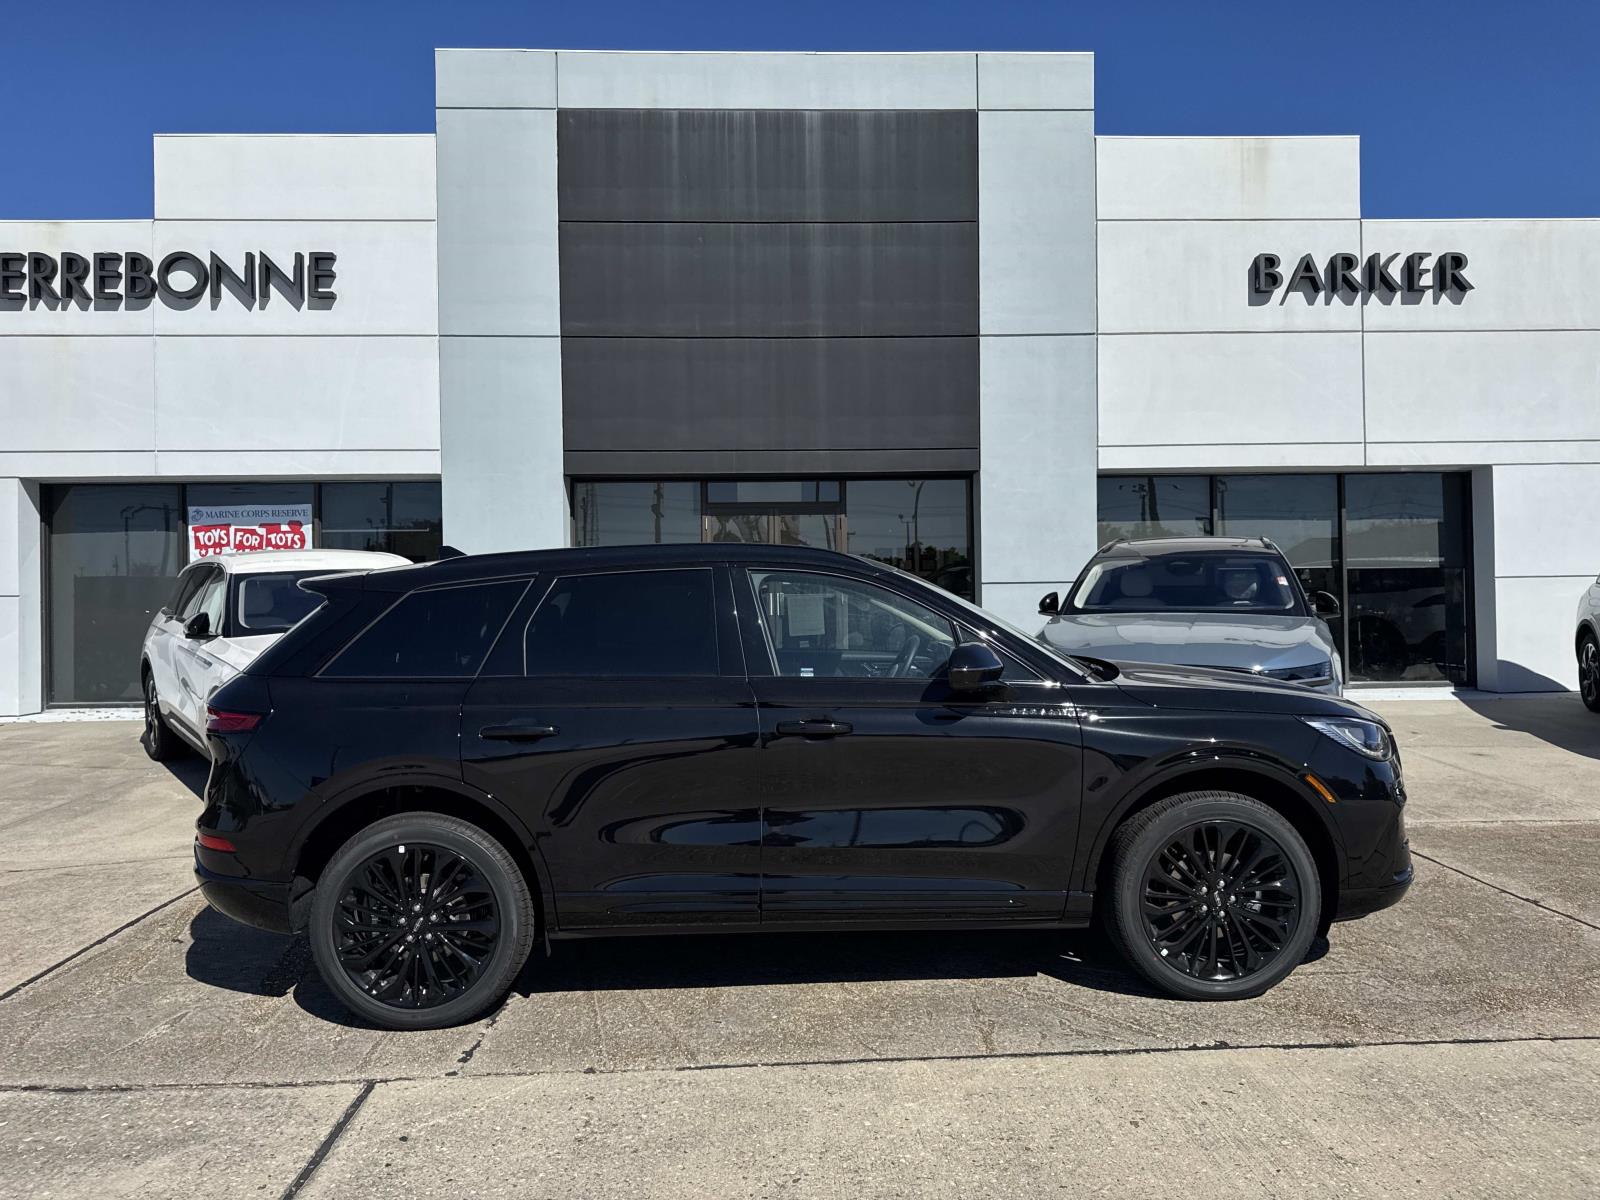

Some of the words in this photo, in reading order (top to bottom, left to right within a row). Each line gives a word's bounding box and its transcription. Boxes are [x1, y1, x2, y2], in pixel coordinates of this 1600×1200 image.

[1254, 252, 1475, 294] BARKER
[205, 509, 239, 519] MARINE
[240, 509, 270, 518] CORPS
[271, 508, 308, 518] RESERVE
[196, 528, 228, 546] TOYS
[235, 531, 260, 547] FOR
[267, 533, 301, 548] TOTS
